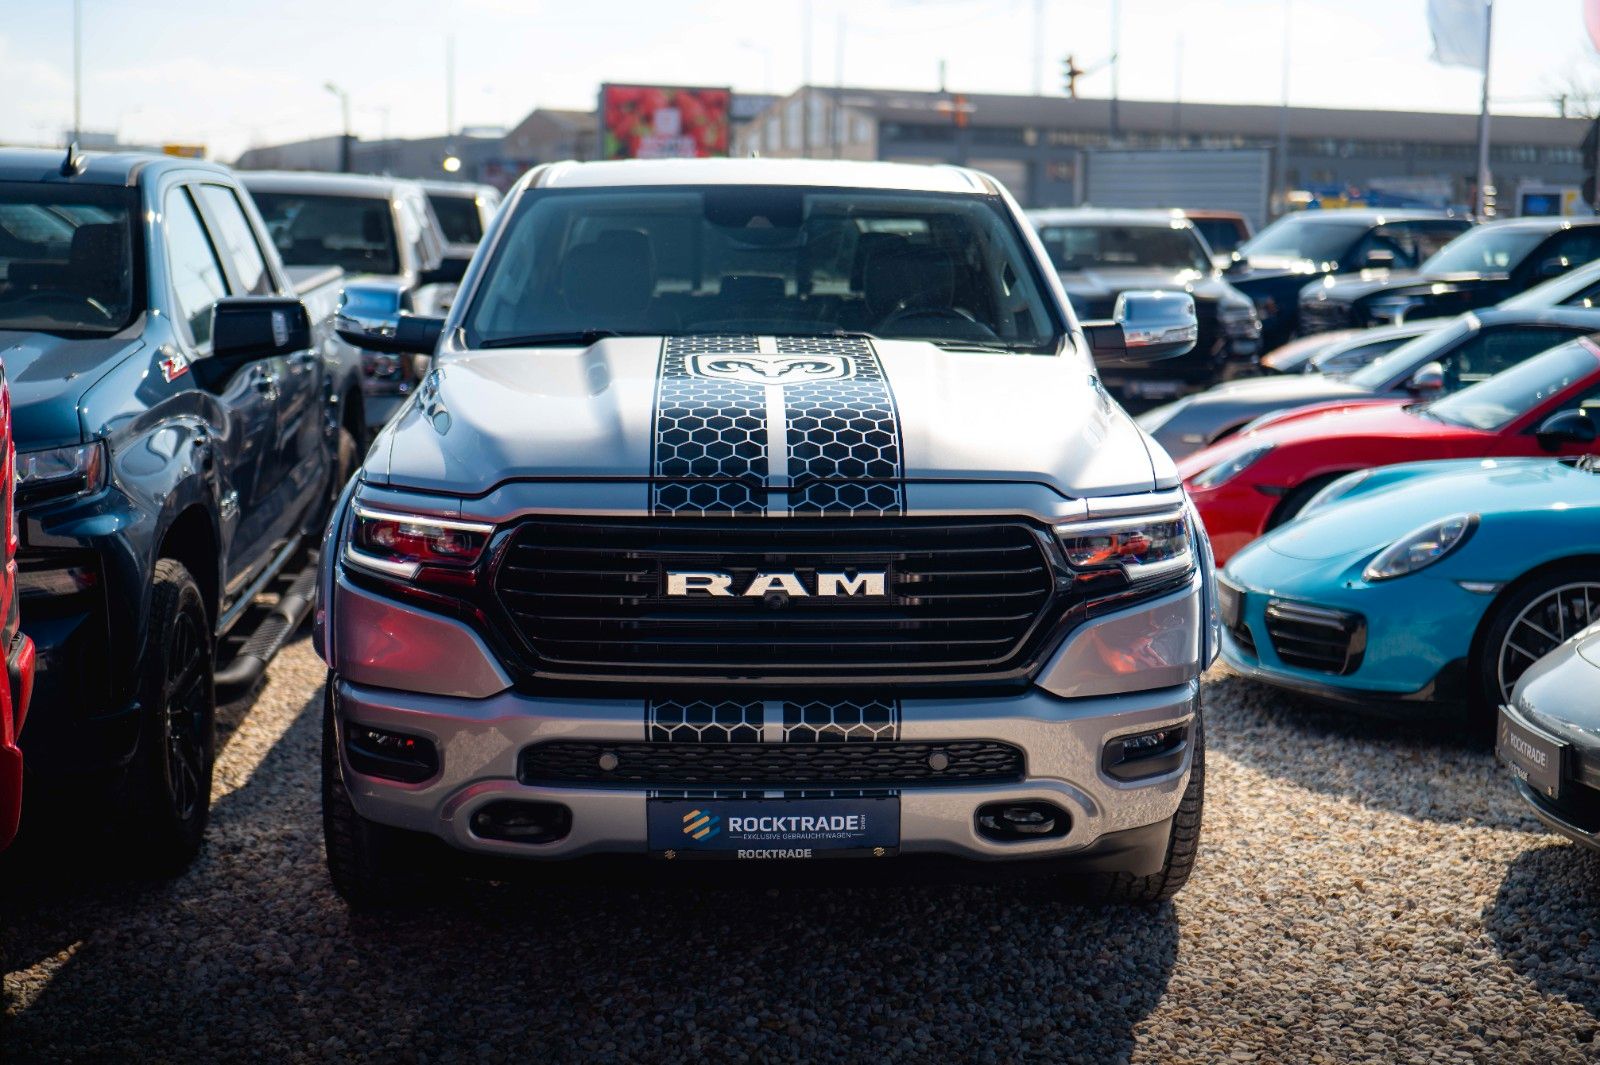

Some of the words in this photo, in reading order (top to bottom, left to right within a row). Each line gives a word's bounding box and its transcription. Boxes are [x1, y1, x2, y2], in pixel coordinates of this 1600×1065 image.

[667, 572, 886, 596] RAM
[1510, 733, 1546, 767] ROCKTRADE
[729, 815, 859, 832] ROCKTRADE
[782, 832, 852, 840] GEBRAUCHTWAGEN
[738, 848, 812, 859] ROCKTRADE
